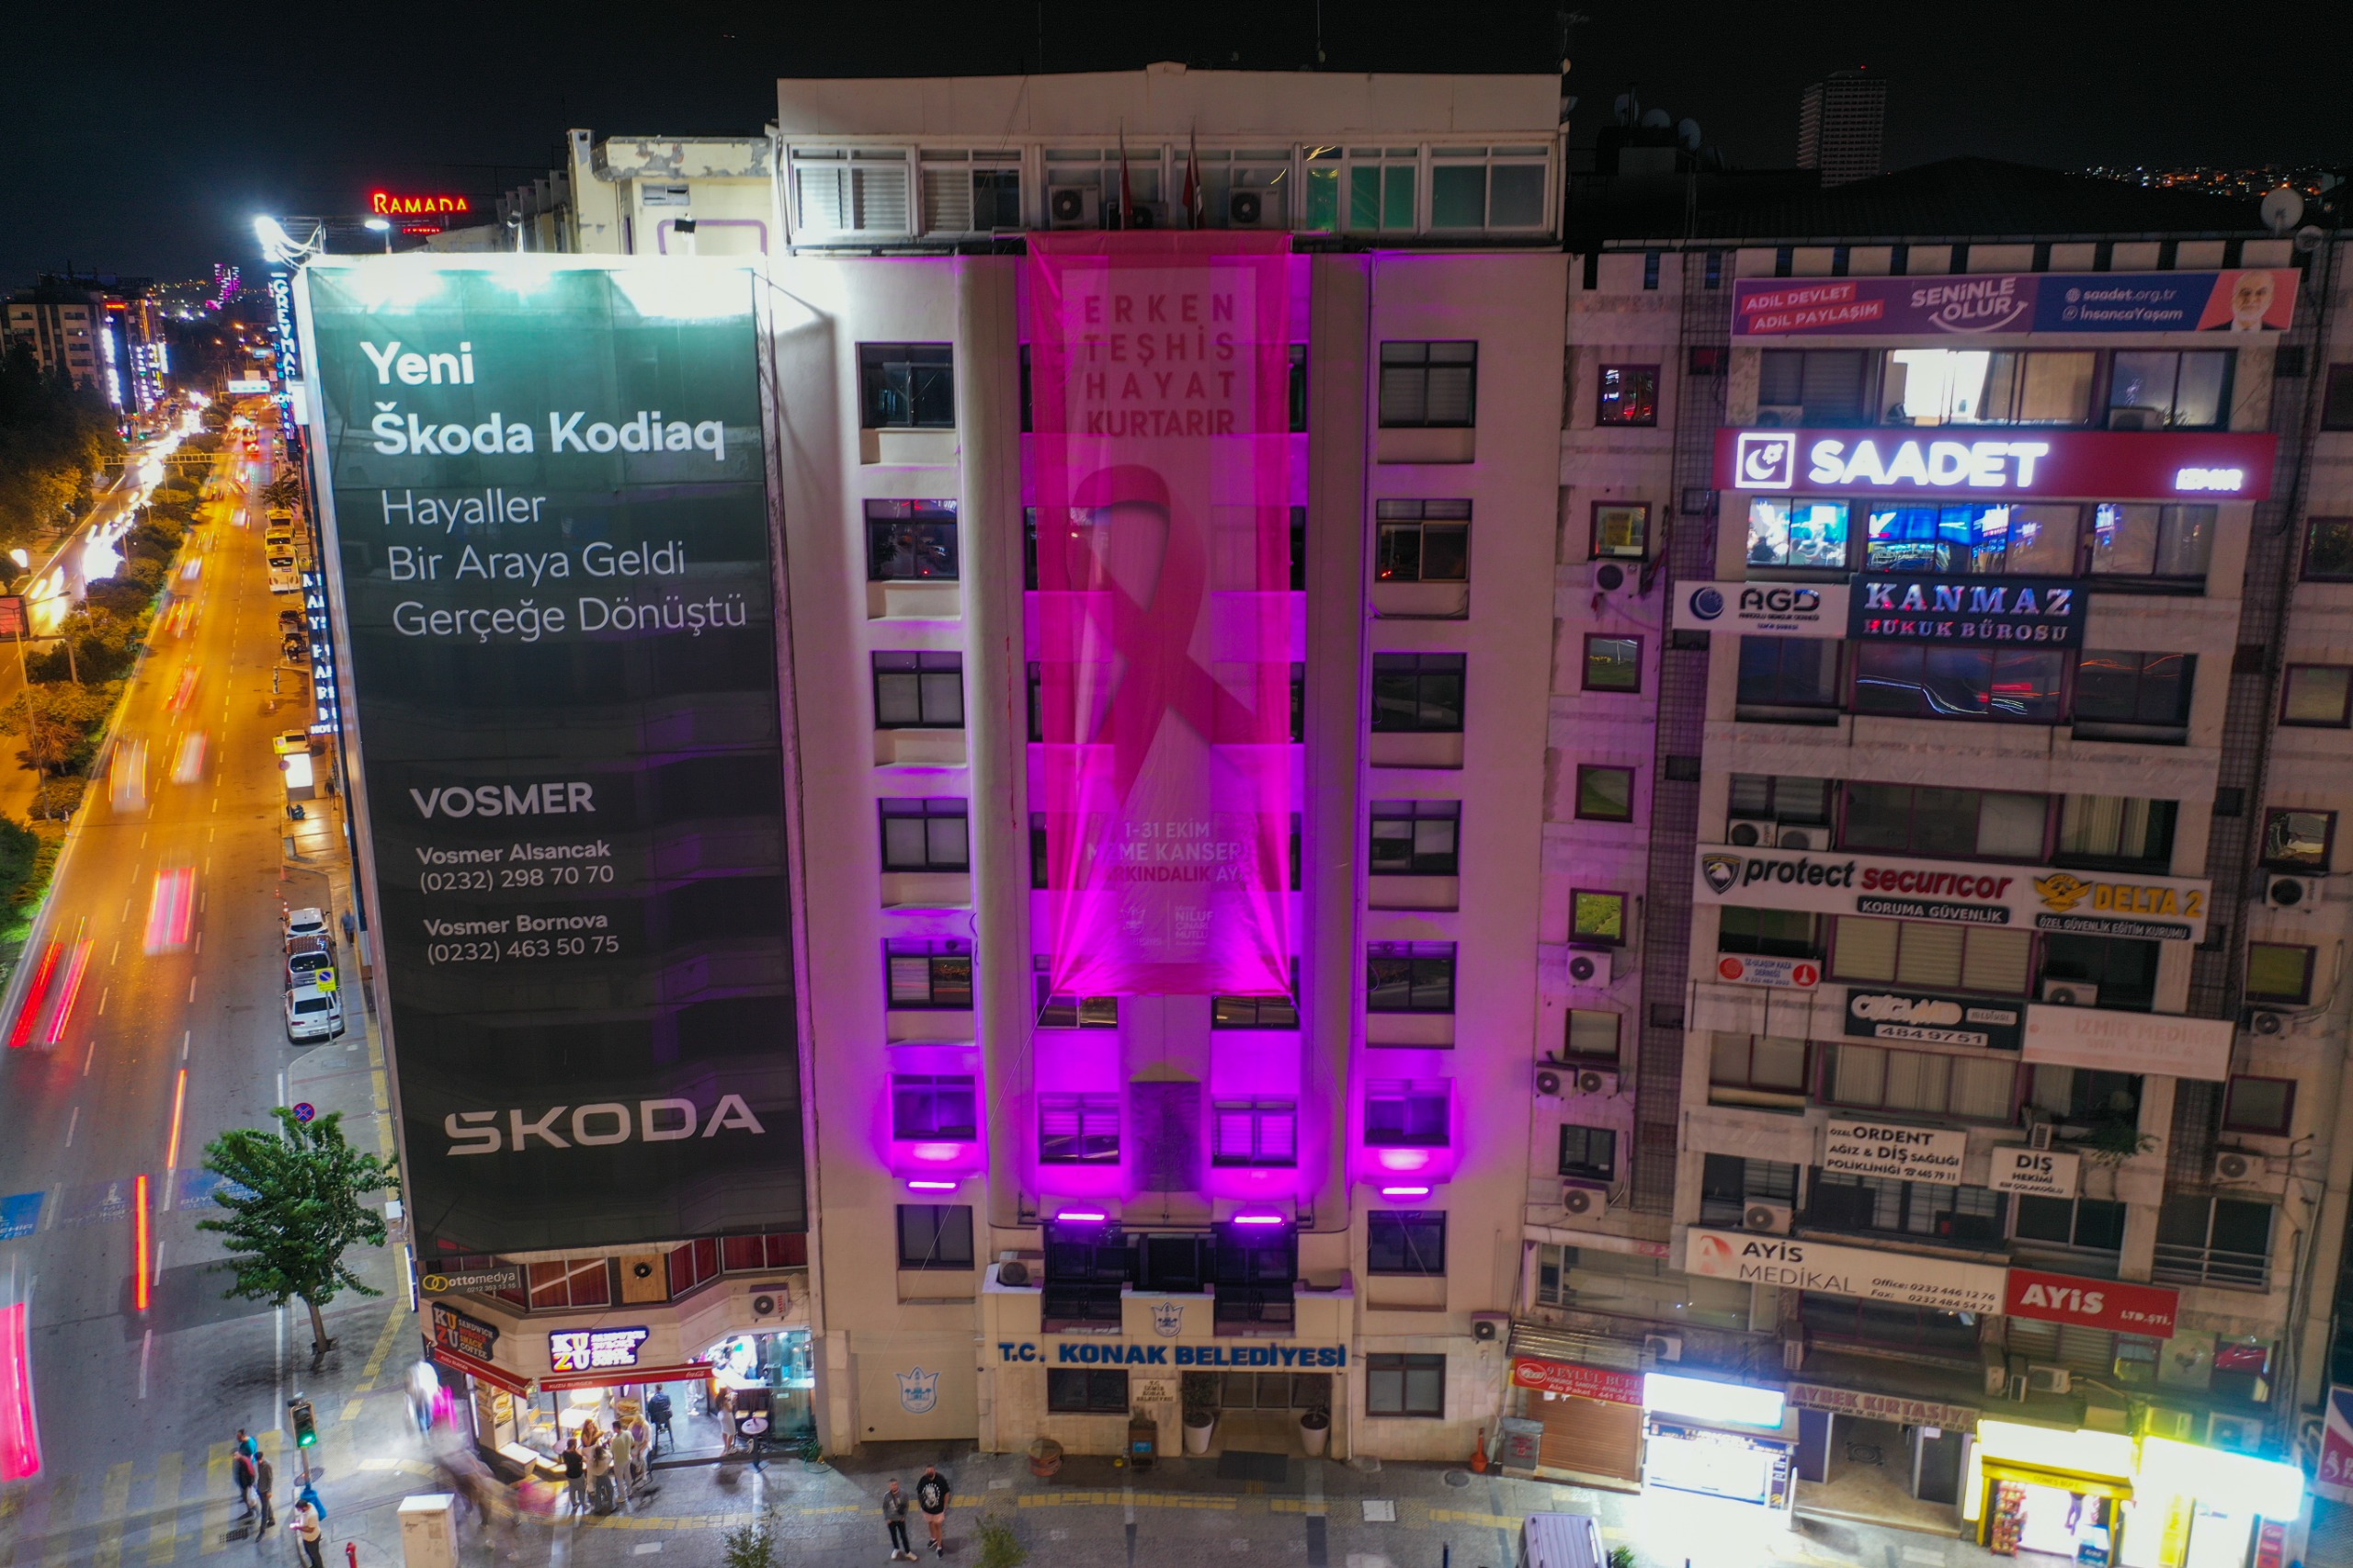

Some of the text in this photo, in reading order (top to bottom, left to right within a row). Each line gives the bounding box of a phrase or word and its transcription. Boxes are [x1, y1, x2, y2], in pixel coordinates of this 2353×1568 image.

[373, 193, 467, 214] RAMADA
[1787, 286, 1851, 305] DEVLET
[1912, 277, 2017, 308] SENİNLE
[2083, 288, 2177, 303] saadet.org.tr
[1084, 293, 1233, 324] ERKEN
[1794, 302, 1879, 324] PAYLAŞIM
[1942, 295, 2013, 321] OLUR
[1084, 324, 1234, 367] TEŞHİS
[359, 341, 475, 385] Yeni
[1086, 370, 1235, 400] HAYAT
[371, 401, 726, 461] Škoda Kodiaq
[1087, 409, 1235, 437] KURTARIR
[1808, 439, 2049, 487] SAADET
[381, 488, 547, 534] Hayaller
[388, 540, 685, 587] Bir Araya Geldi
[1739, 588, 1820, 611] AGD
[1864, 582, 2074, 617] KANMAZ
[392, 593, 746, 643] Gerçeğe Dönüştü
[1862, 619, 2068, 642] HUKUK BÜROSU
[409, 782, 597, 819] VOSMER
[1165, 817, 1211, 839] EKİM
[415, 839, 612, 866] Vosmer Alsancak
[1086, 842, 1149, 862] MME
[420, 864, 614, 894] (0232) 298 70 70
[1743, 857, 1855, 887] protect
[1862, 900, 2004, 923] KORUMA GÜVENLİK
[2094, 882, 2205, 918] DELTA 2
[423, 915, 608, 937] Vosmer Bornova
[2039, 915, 2188, 939] ÖZEL GÜVENLİK EĞİTİM KURUMU
[427, 935, 620, 965] (0232) 463 50 75
[2074, 1017, 2130, 1040] İZMİR
[1853, 1126, 1935, 1146] ORDENT
[1829, 1143, 1960, 1166] AĞIZ & DİŞ SAĞLIĞI
[2016, 1153, 2053, 1176] DİŞ
[1827, 1158, 1901, 1176] POLİKLİNİĞİ
[2012, 1171, 2053, 1185] HEKİMİ
[1742, 1241, 1803, 1263] AYİS
[449, 1271, 516, 1287] ottomedya
[1739, 1263, 1858, 1293] MEDİKAL
[1871, 1278, 1996, 1301] Office: 0232 446 12 76
[1870, 1289, 1995, 1312] Fax: 0232 484 54 73
[2019, 1283, 2105, 1314] AYİS
[433, 1307, 458, 1330] KU
[459, 1318, 494, 1339] SANDWICH
[436, 1324, 459, 1348] ZU
[460, 1335, 483, 1349] SNACK
[551, 1333, 590, 1353] KU
[460, 1342, 488, 1359] COFFEE
[552, 1349, 591, 1370] ZU
[998, 1342, 1346, 1368] T.C. KONAK BELEDİYESİ
[1546, 1366, 1554, 1375] 9
[1556, 1367, 1603, 1384] EYLÜL
[1548, 1383, 1564, 1392] Alo
[1565, 1385, 1591, 1395] Paket
[1792, 1385, 1976, 1425] AYBEK KIRTASİYE
